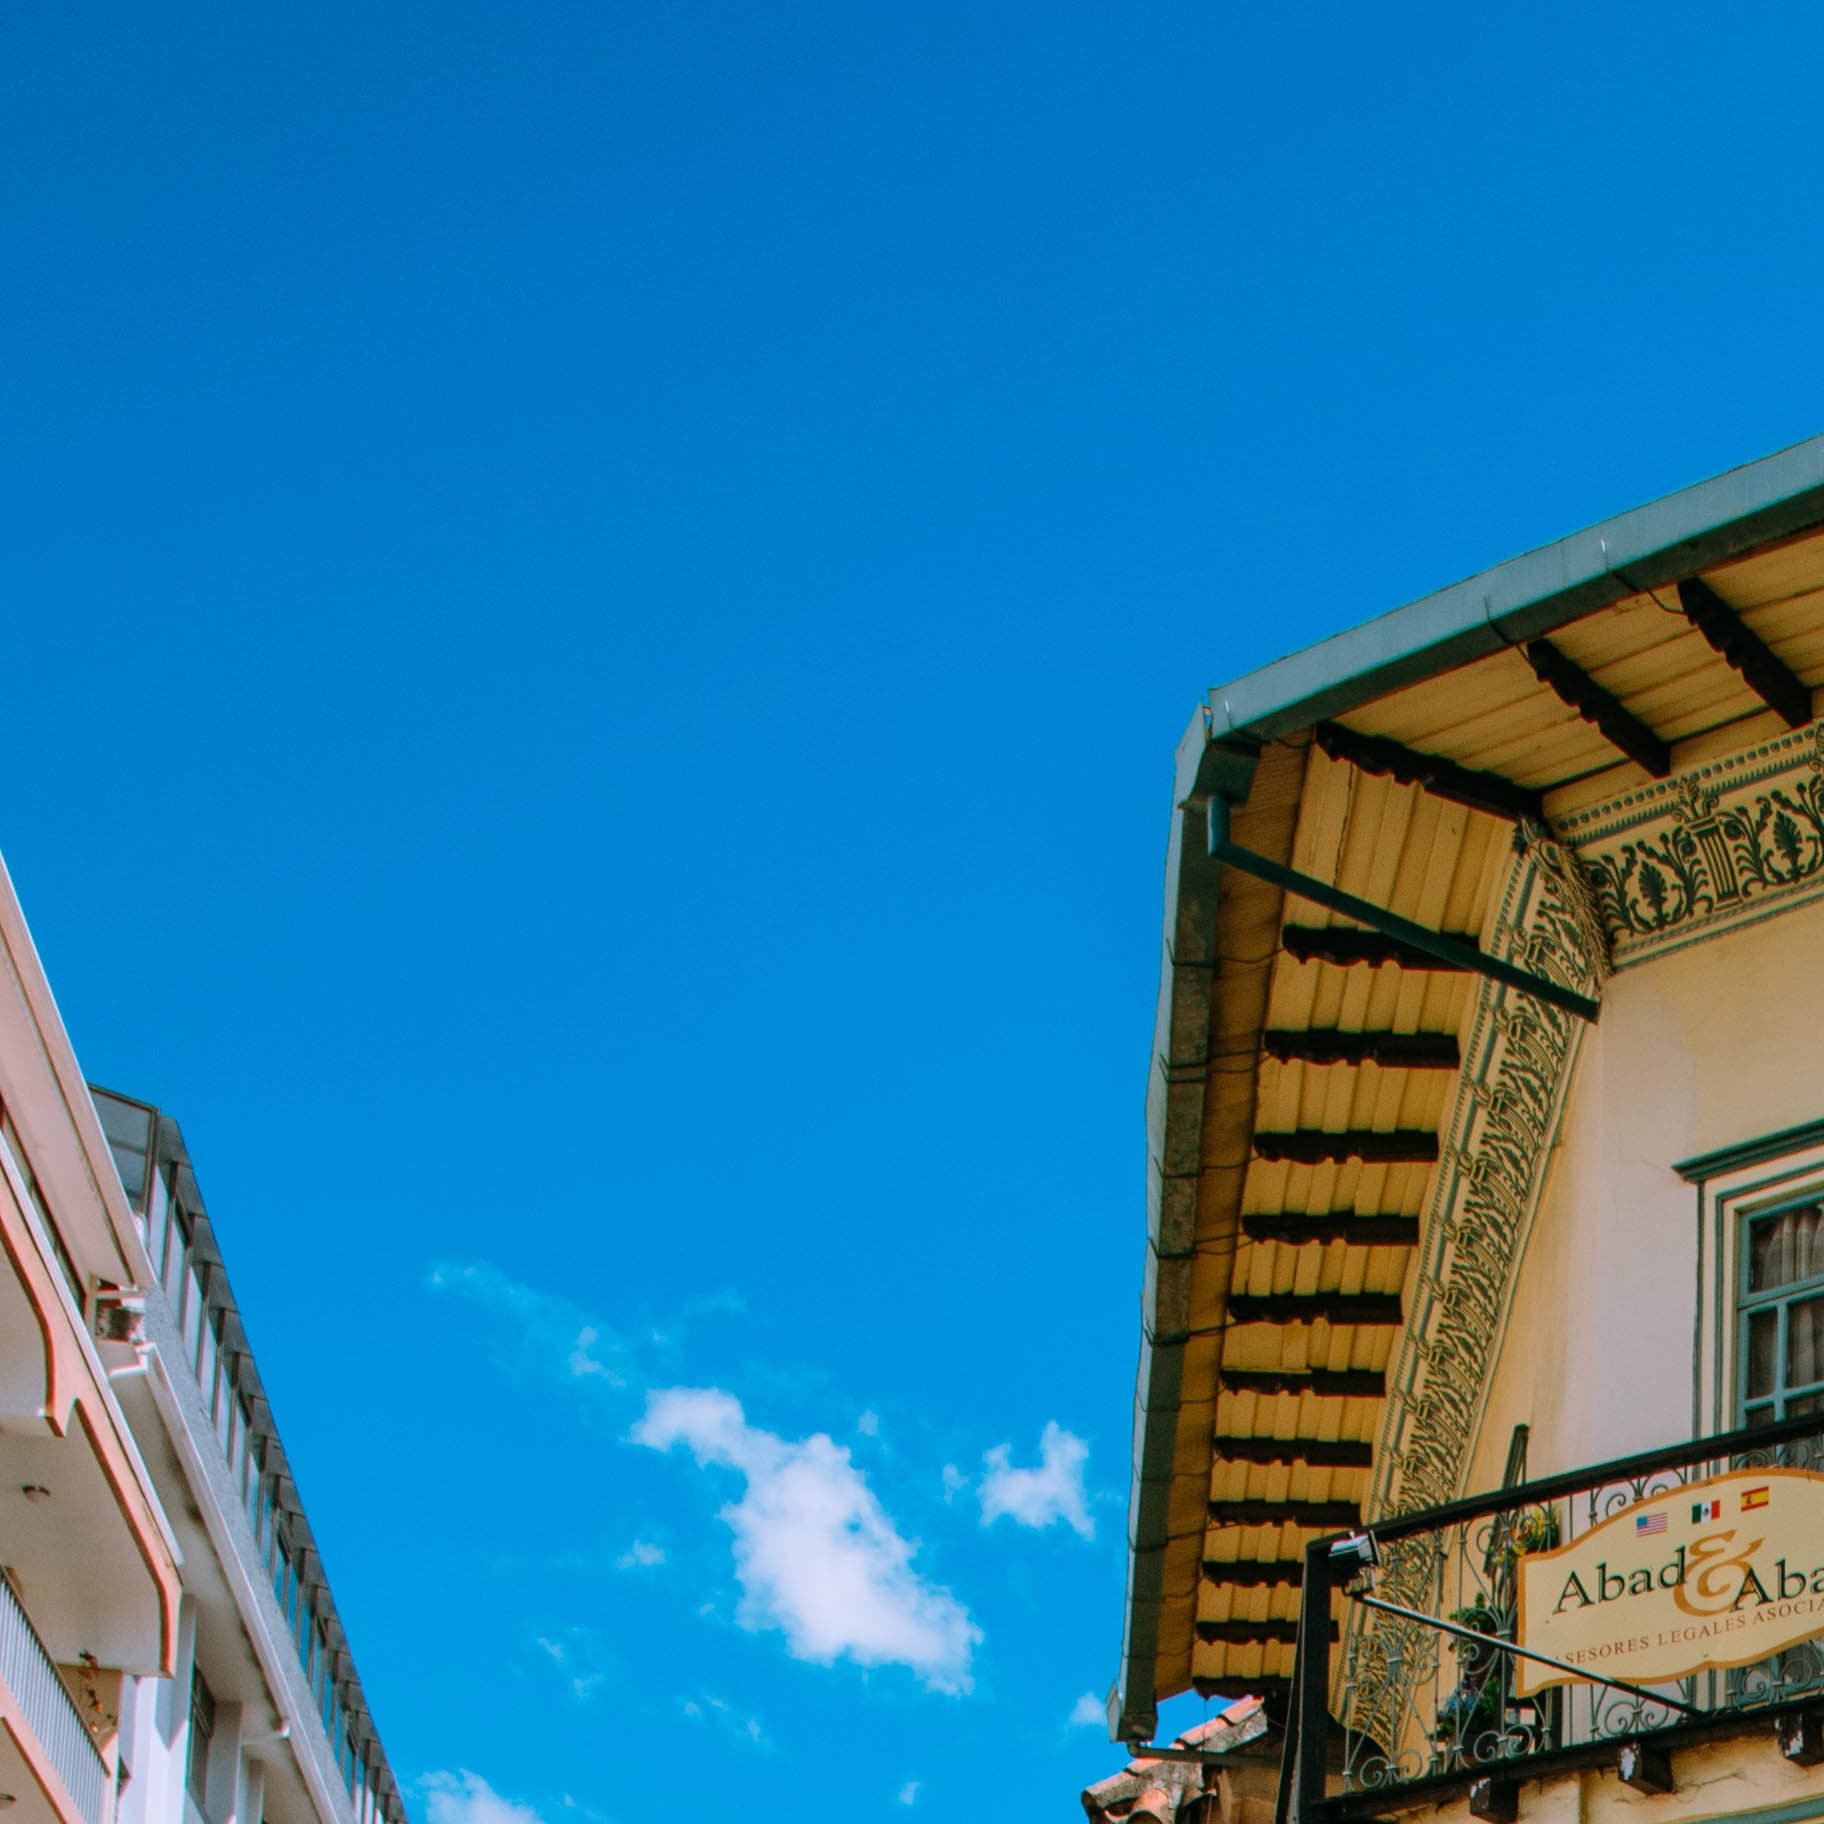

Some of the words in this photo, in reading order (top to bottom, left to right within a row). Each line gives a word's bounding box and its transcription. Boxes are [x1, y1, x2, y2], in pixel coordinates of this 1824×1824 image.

[1551, 1545, 1686, 1616] Abad
[1674, 1529, 1766, 1617] &
[1555, 1635, 1650, 1665] SESORES
[1657, 1616, 1747, 1647] LEGALES
